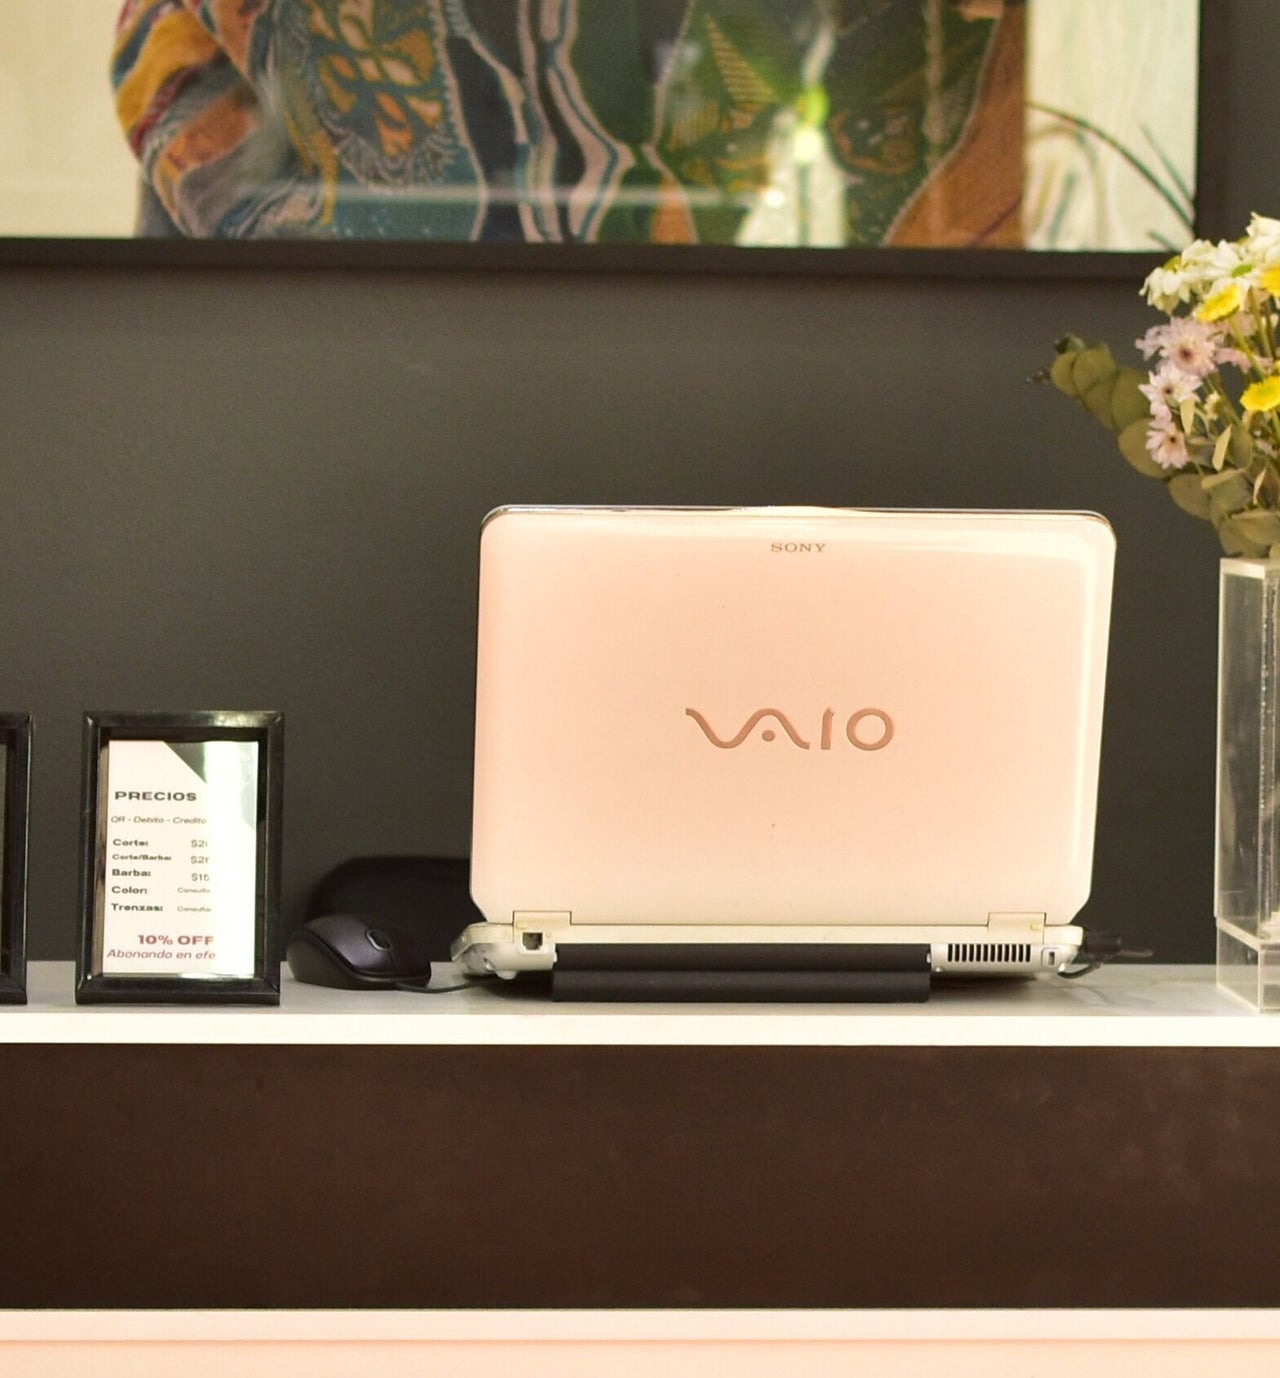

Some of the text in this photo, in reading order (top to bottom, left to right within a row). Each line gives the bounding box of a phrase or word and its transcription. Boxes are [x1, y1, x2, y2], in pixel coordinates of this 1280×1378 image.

[770, 541, 827, 553] SONY
[684, 706, 895, 752] VAIO
[114, 791, 198, 802] PRECIOS
[137, 934, 214, 946] 10% OFF
[106, 948, 173, 960] Abonando
[175, 951, 192, 960] en
